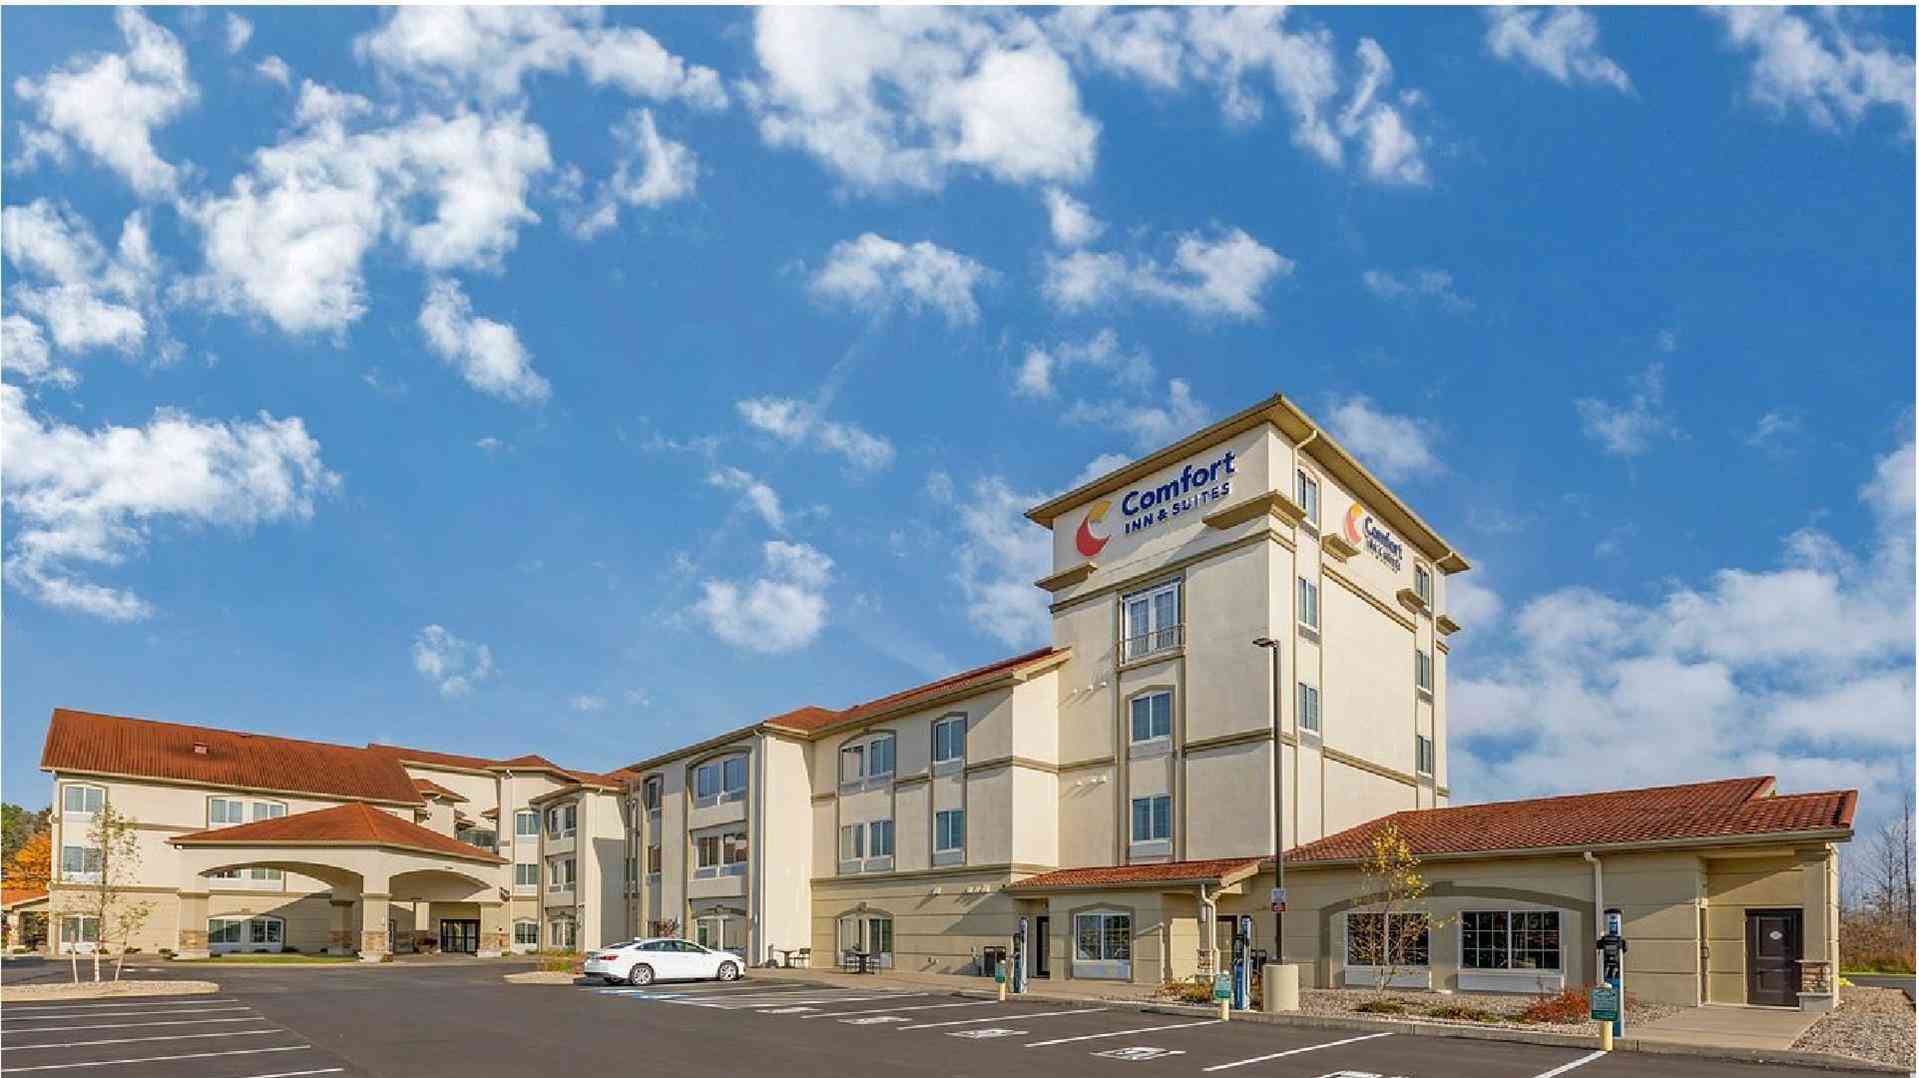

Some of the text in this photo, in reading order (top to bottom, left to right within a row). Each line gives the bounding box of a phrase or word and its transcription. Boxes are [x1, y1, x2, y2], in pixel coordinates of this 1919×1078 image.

[1121, 450, 1236, 516] Comfort
[1125, 482, 1231, 534] INN & SUITES
